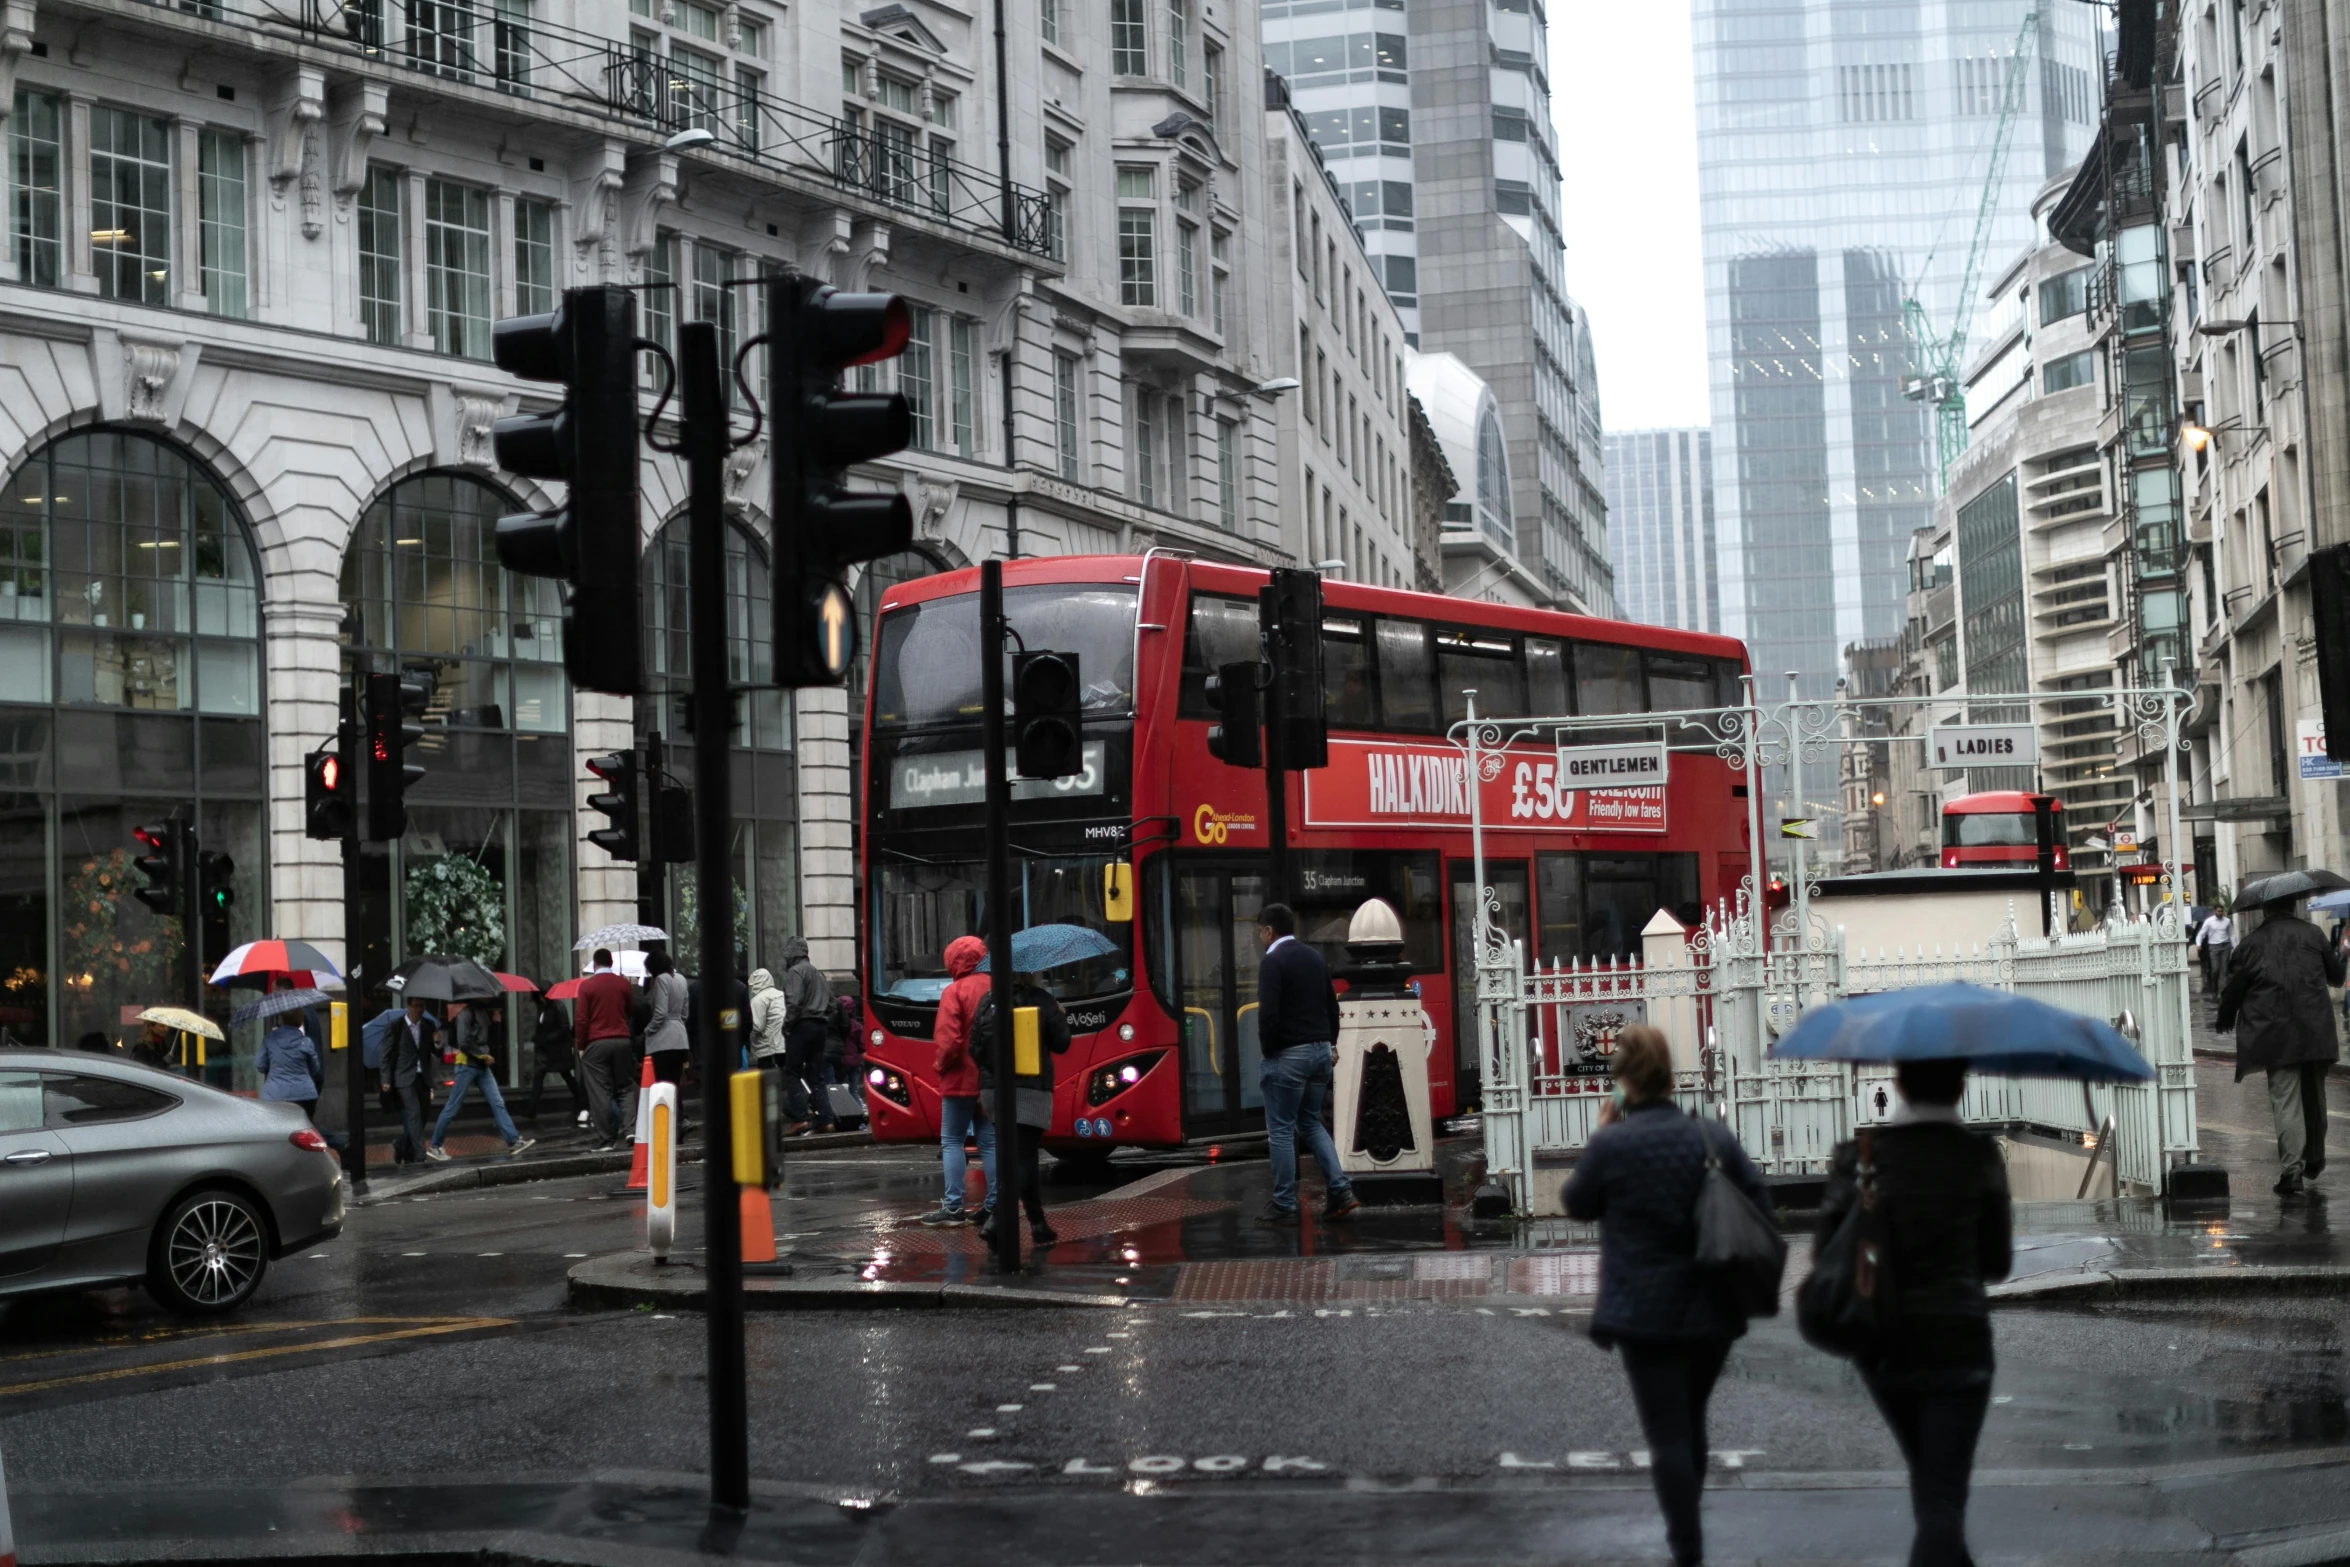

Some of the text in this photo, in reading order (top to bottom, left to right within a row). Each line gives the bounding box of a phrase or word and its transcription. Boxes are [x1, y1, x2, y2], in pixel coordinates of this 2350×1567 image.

[1956, 738, 2014, 755] LADIES
[1569, 756, 1658, 776] GENTLEMEN
[904, 766, 961, 798] Clapham
[1368, 753, 1472, 815] HALKIDIKI
[1588, 799, 1661, 820] Friendly low fares
[1194, 804, 1227, 844] Go
[1303, 870, 1365, 890] 35 Clapham Junction
[891, 1020, 921, 1028] VOLVO
[1577, 1065, 1594, 1073] CITY
[1594, 1064, 1605, 1072] OF
[1061, 1454, 1329, 1474] LOOK
